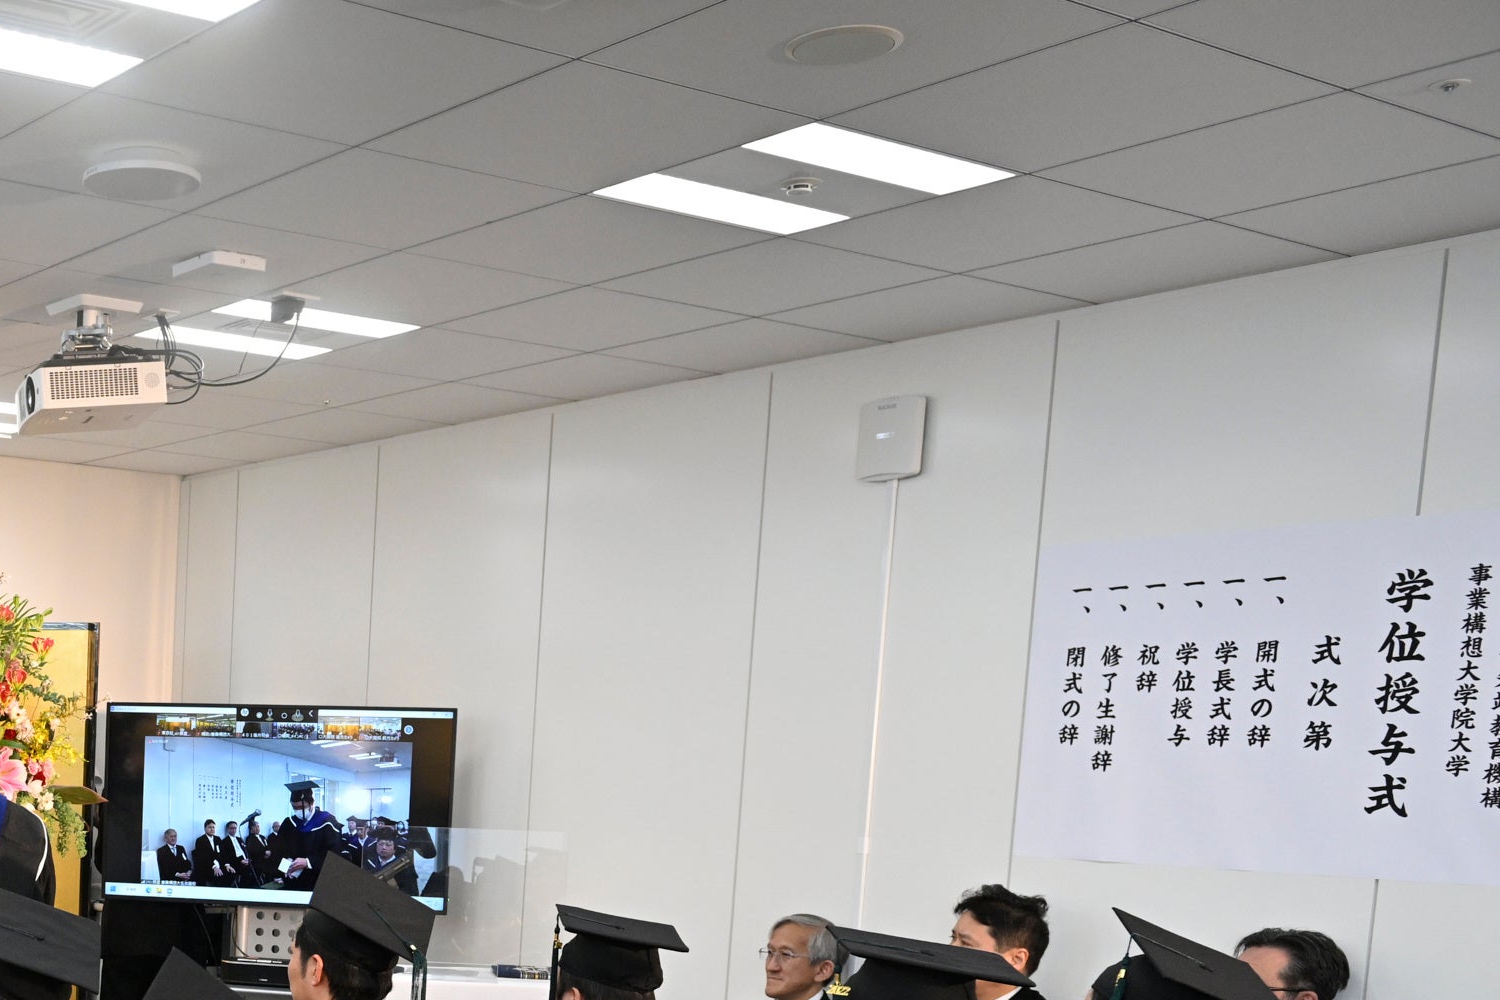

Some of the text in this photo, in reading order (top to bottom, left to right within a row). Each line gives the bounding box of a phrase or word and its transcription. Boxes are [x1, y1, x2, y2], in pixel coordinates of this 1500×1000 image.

[1303, 634, 1342, 752] 式次第
[1363, 568, 1435, 818] 学位授与式
[1445, 562, 1493, 778] 事業構想大学院大学
